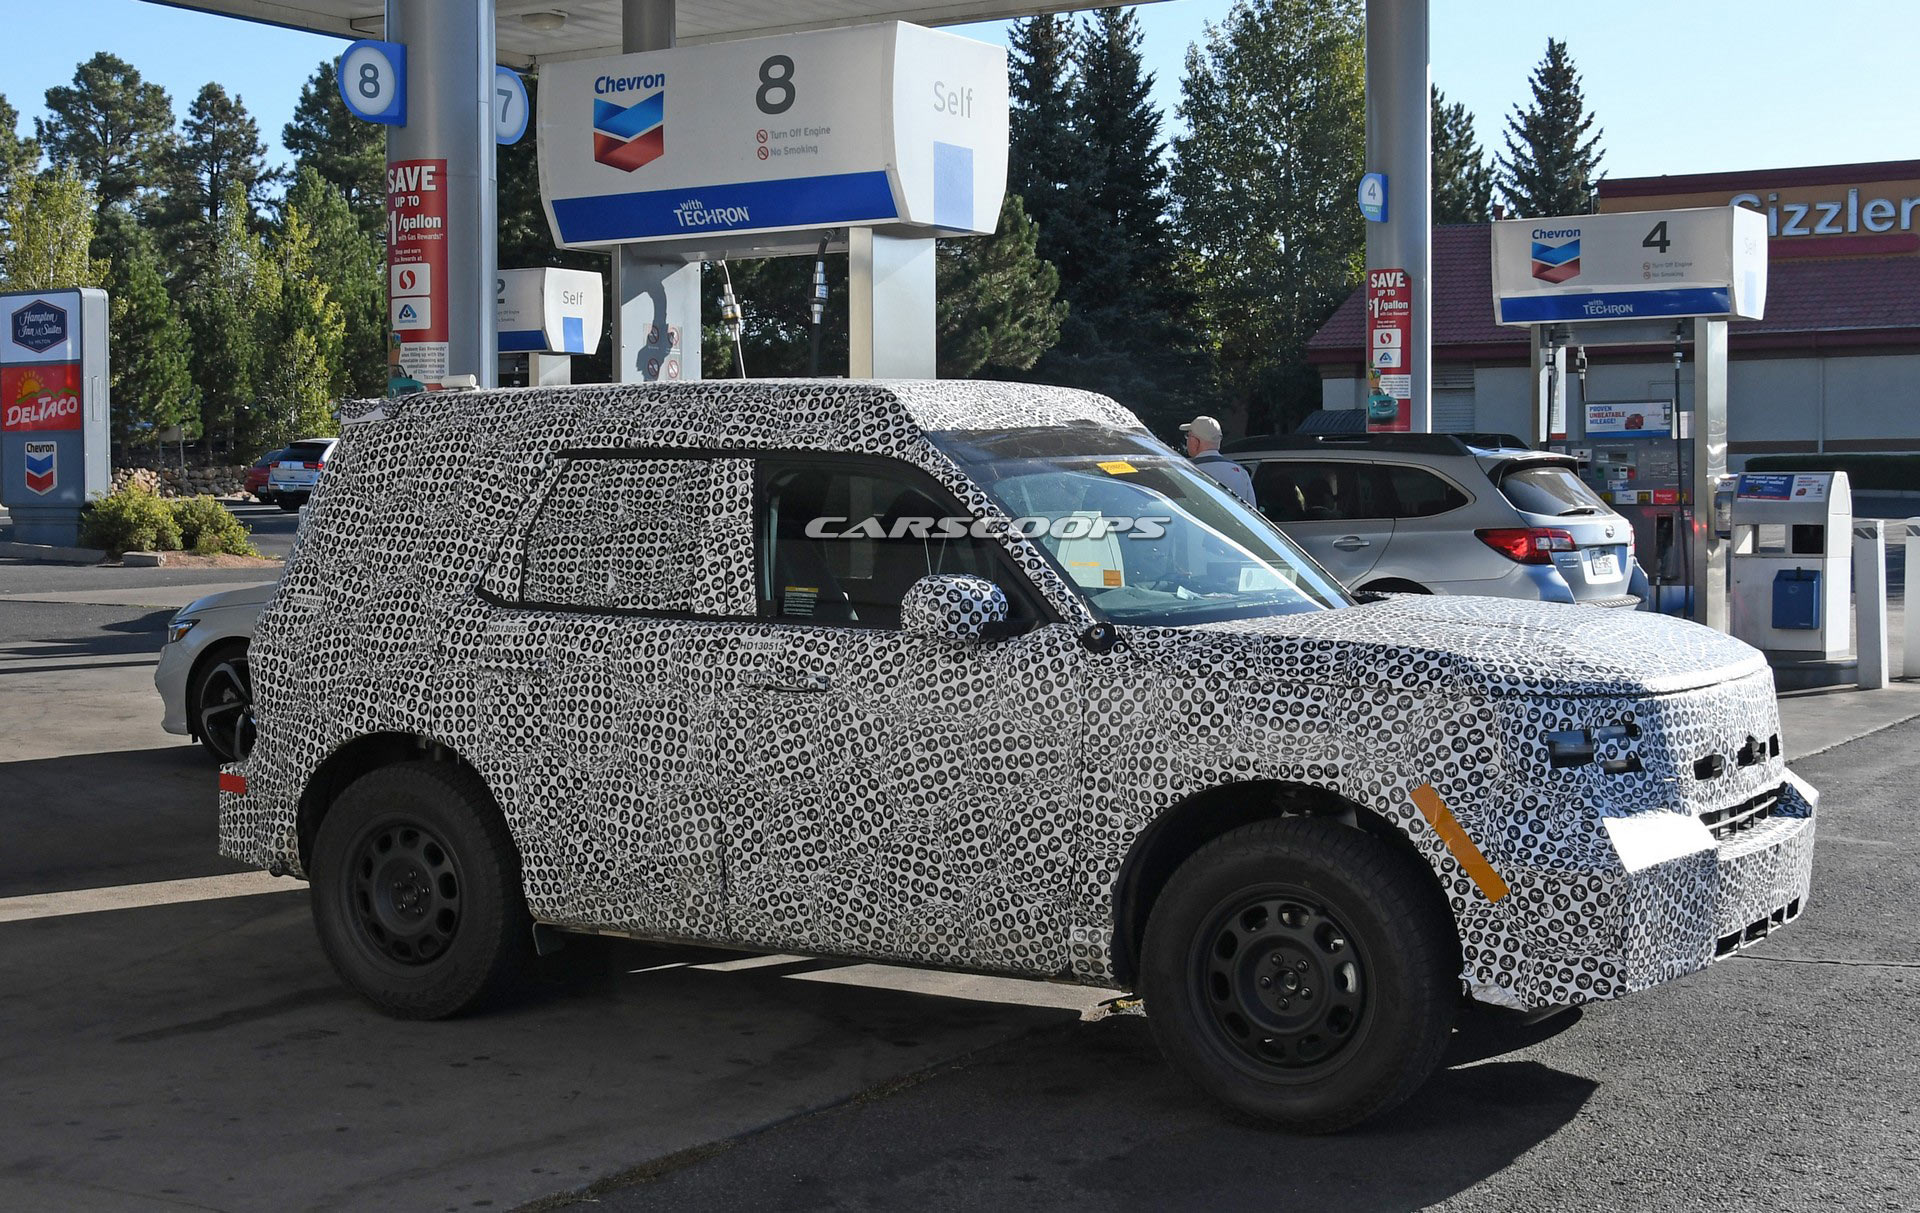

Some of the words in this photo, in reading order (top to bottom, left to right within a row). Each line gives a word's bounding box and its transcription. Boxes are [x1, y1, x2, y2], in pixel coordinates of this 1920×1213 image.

[359, 63, 380, 98] 8
[594, 73, 665, 94] Chevron
[756, 55, 796, 114] 8
[497, 88, 512, 123] 7
[934, 81, 972, 118] Self
[770, 130, 788, 140] Turn
[790, 128, 801, 137] Off
[804, 126, 831, 137] Engine
[770, 148, 781, 156] No
[784, 145, 818, 155] Smoking
[388, 166, 436, 194] SAVE
[1368, 182, 1376, 200] 4
[395, 196, 405, 208] UP
[407, 196, 419, 206] TO
[680, 200, 703, 210] with
[673, 206, 750, 226] TECHRON
[1532, 228, 1580, 239] Chevron
[1642, 221, 1670, 253] 4
[1371, 272, 1405, 288] SAVE
[563, 291, 583, 305] Self
[1583, 304, 1633, 315] TECHRON
[19, 311, 57, 325] Hampton
[18, 325, 35, 337] Inn
[42, 323, 62, 335] Suites
[6, 406, 40, 427] DEL
[38, 396, 78, 421] TACO
[26, 443, 54, 453] Chevron
[292, 596, 323, 607] HD130515
[488, 624, 527, 634] HD130515
[740, 642, 784, 651] HD130515
